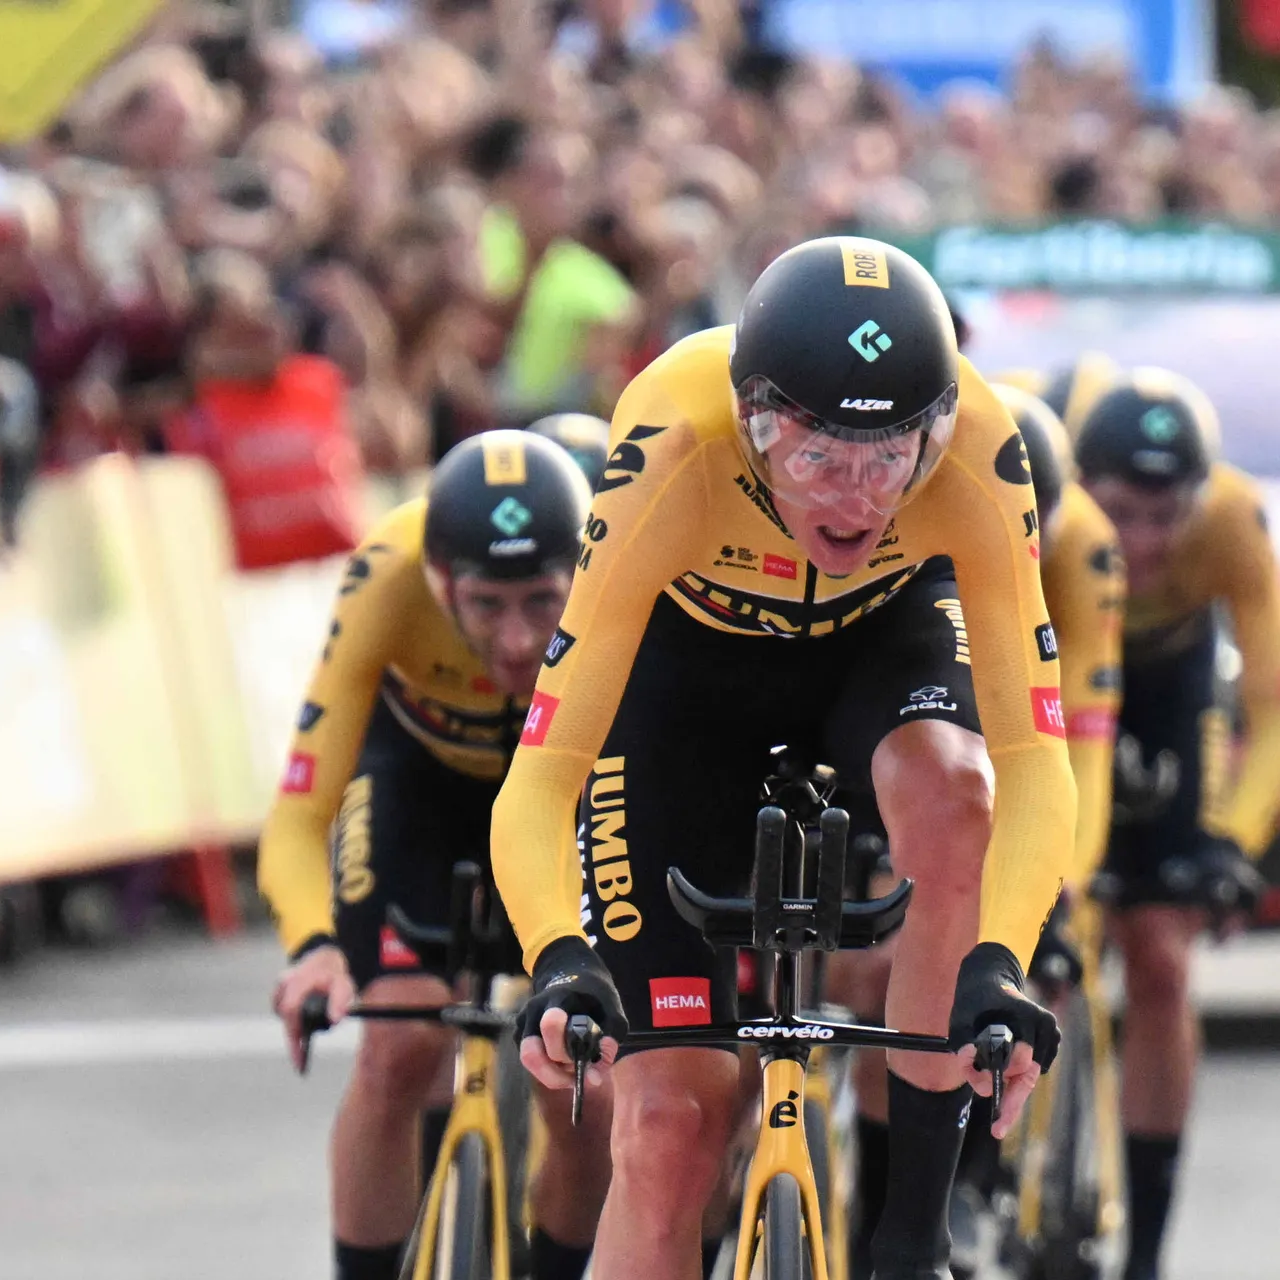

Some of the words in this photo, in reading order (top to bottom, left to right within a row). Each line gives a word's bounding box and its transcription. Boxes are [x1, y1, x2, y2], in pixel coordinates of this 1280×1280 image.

[839, 398, 894, 411] LAZER
[899, 701, 958, 717] AGU
[590, 755, 643, 942] JUMBO
[782, 903, 814, 912] GARMIN
[655, 994, 707, 1010] HEMA
[737, 1025, 835, 1040] cervélo
